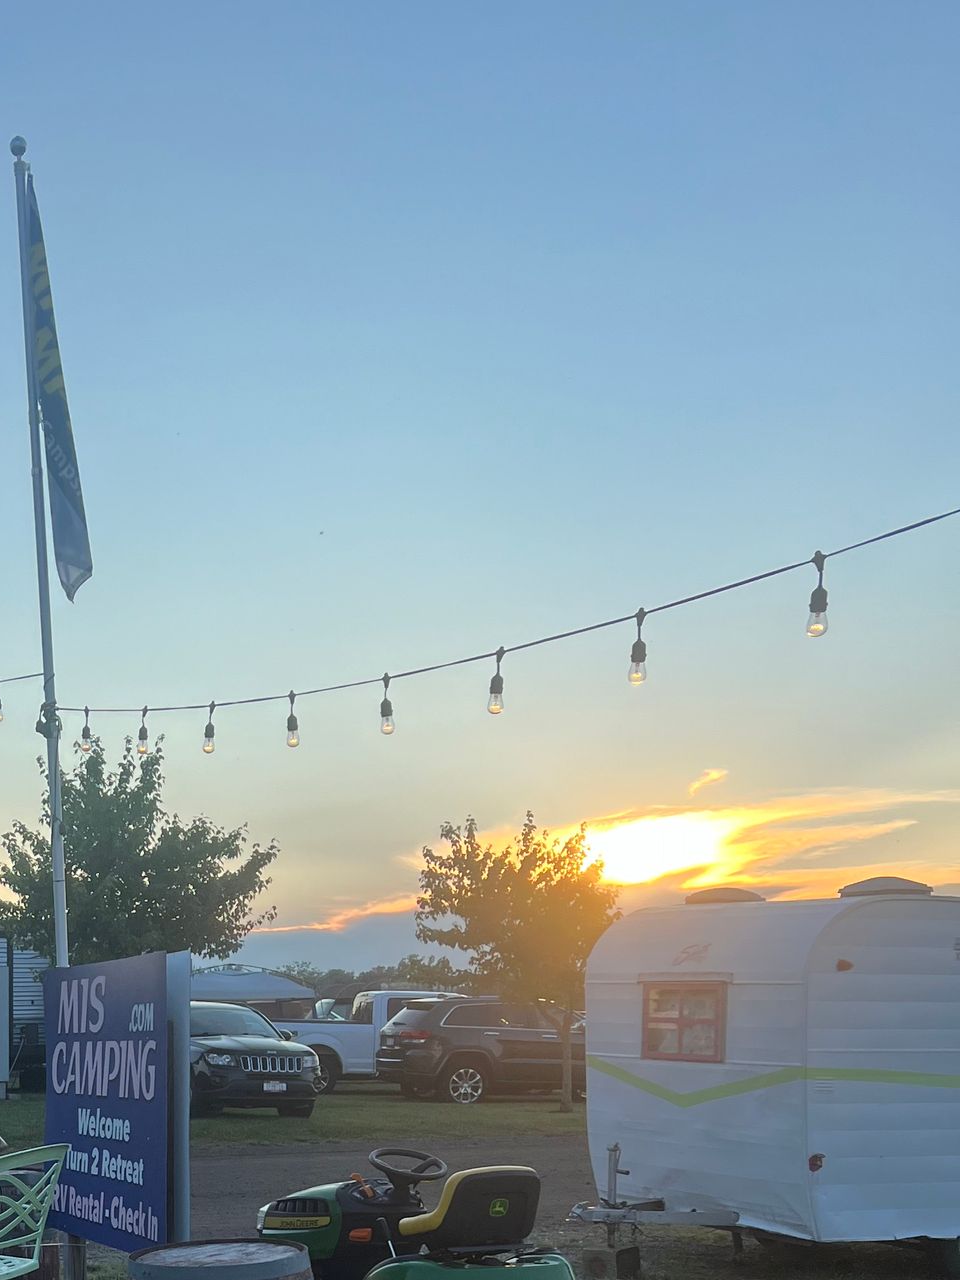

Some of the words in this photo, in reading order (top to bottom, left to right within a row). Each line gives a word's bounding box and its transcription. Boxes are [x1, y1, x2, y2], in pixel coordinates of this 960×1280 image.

[57, 975, 106, 1034] MIS
[128, 1003, 154, 1032] .COM
[51, 1040, 157, 1101] CAMPING
[77, 1107, 131, 1142] Welcome
[90, 1147, 100, 1176] 2
[101, 1149, 144, 1186] Retreat
[68, 1186, 105, 1224] Rental
[110, 1195, 146, 1238] Check
[147, 1206, 159, 1242] In
